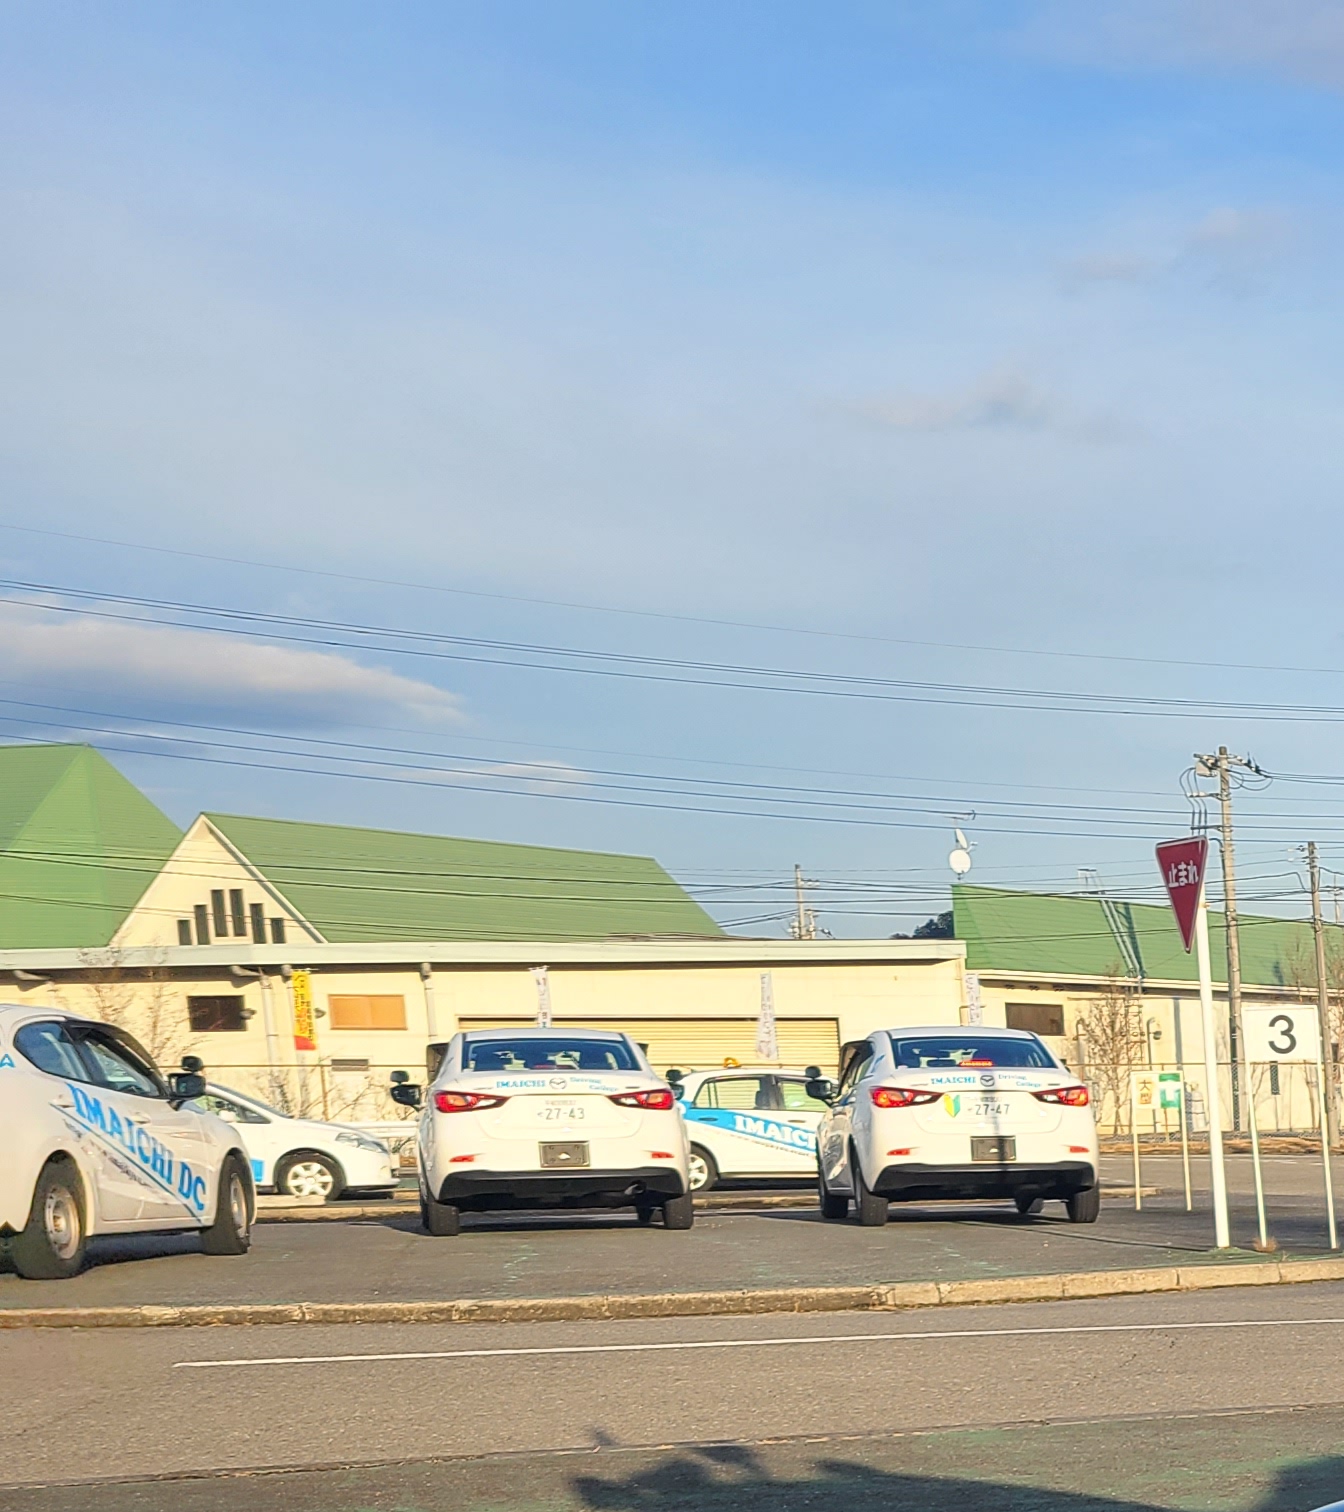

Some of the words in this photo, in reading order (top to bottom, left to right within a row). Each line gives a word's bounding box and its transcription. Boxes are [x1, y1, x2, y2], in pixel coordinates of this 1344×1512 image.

[1168, 859, 1199, 888] 止まれ
[1268, 1014, 1297, 1054] 3
[496, 1080, 546, 1089] IMAICHI
[931, 1076, 976, 1085] IMAICHI
[66, 1082, 174, 1186] IMAICHI
[177, 1160, 207, 1211] DC
